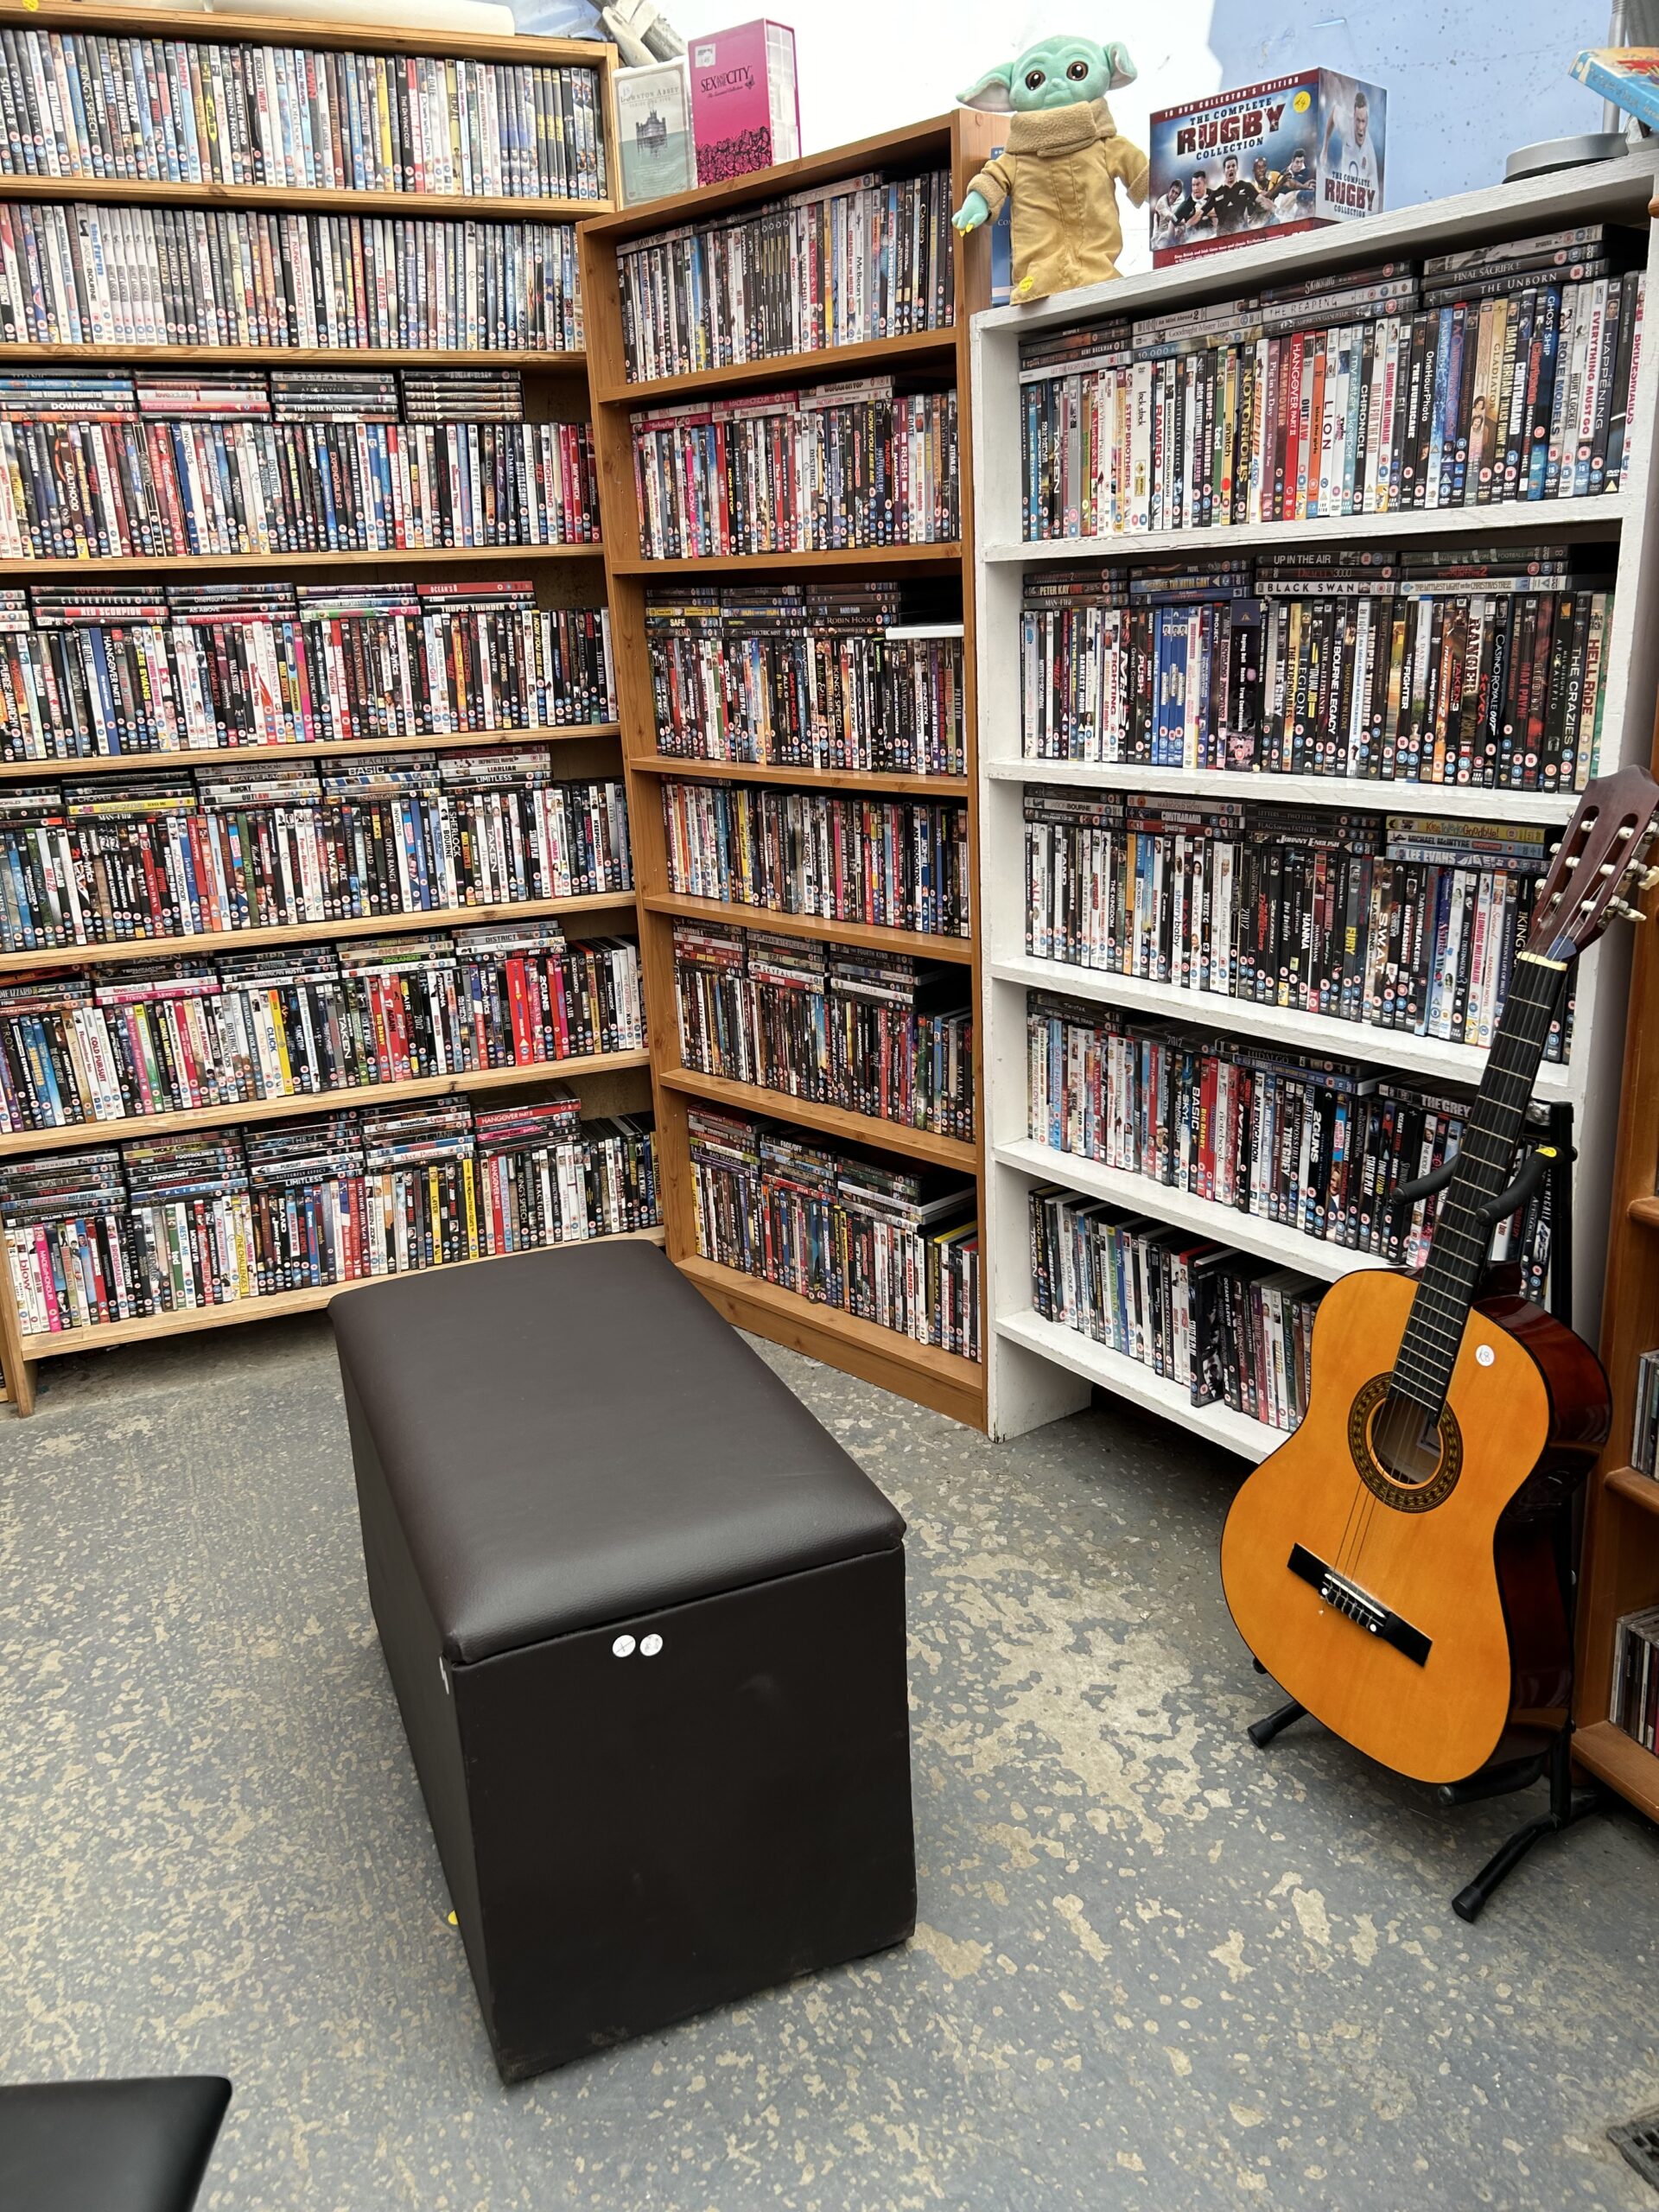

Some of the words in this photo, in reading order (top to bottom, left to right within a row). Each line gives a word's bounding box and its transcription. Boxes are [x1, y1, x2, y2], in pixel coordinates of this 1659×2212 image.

[701, 77, 716, 92] SEX
[726, 66, 753, 84] CITY
[1262, 76, 1300, 92] EDITION
[1190, 113, 1210, 125] THE
[1213, 98, 1272, 119] COMPLETE
[1177, 103, 1286, 156] RUGBY
[1196, 137, 1263, 160] COLLECTION
[1325, 178, 1376, 212] RUGBY
[1344, 174, 1370, 187] COMPLETE
[1334, 204, 1365, 218] COLLECTION
[1453, 270, 1478, 283] FINAL
[1480, 283, 1501, 295] THE
[1507, 273, 1556, 289] UNBORN
[1292, 296, 1337, 314] REAPING
[1546, 296, 1554, 331] GHOST
[1169, 327, 1197, 338] Goodnight
[1198, 323, 1215, 333] Mister
[1543, 333, 1552, 355] SHIP
[1587, 310, 1601, 381] EVERYTHING
[1556, 341, 1567, 376] ROLE
[1290, 344, 1301, 408] HANGOVER
[1385, 363, 1395, 400] SLUMDOG
[1421, 352, 1434, 422] OneHourPhoto
[1489, 342, 1500, 409] GLADIATOR
[1571, 374, 1580, 397] HURT
[1595, 332, 1611, 429] HAPPENING
[51, 402, 105, 410] DOWNFALL
[1408, 385, 1417, 438] HURRICANE
[1510, 362, 1526, 435] CONTRABAND
[1552, 379, 1565, 435] MODELS
[1567, 399, 1578, 429] LOCKER
[1584, 386, 1593, 416] MUST
[1239, 368, 1252, 483] NOTORIOUS
[1300, 398, 1310, 441] OUTLAW
[1322, 401, 1334, 449] LION
[1357, 385, 1368, 459] CHRONICLE
[1382, 400, 1392, 444] MILLIONAIRE
[1582, 419, 1590, 434] GO
[183, 430, 194, 465] INVICTUS
[269, 459, 281, 498] DISTRICT
[544, 459, 553, 508] FIGHTING
[1274, 556, 1285, 564] UP
[1287, 556, 1295, 564] IN
[1316, 555, 1331, 563] AIR
[1268, 582, 1309, 592] BLACK
[1318, 584, 1354, 593] SWAN
[81, 607, 97, 616] RED
[99, 607, 141, 616] SCORPION
[1365, 625, 1376, 669] TROPIC
[1569, 648, 1581, 677] THE
[1276, 659, 1285, 683] THE
[1332, 647, 1341, 690] BOURNE
[1275, 685, 1284, 717] GREY
[1296, 658, 1308, 716] LEGION
[1362, 671, 1372, 727] THUNDER
[1402, 666, 1411, 710] FIGHTER
[1328, 693, 1338, 735] LEGACY
[1564, 681, 1578, 745] CRAZIES
[347, 766, 385, 776] BASIC
[476, 773, 512, 783] LIMITLESS
[1161, 811, 1201, 824] CONTRABAND
[1276, 835, 1307, 845] JOHNNY
[1308, 838, 1339, 848] ENGLISH
[1405, 849, 1421, 860] LEE
[1423, 850, 1456, 862] EVANS
[1172, 890, 1183, 947] sherrybaby
[1301, 912, 1312, 950] HANNA
[1413, 893, 1425, 973] DAYBREAKERS
[1476, 912, 1486, 943] SLUMDOG
[486, 933, 516, 943] DISTRICT
[1345, 926, 1357, 956] FURY
[762, 967, 793, 978] SKYFALL
[266, 1027, 276, 1052] CLICK
[338, 1013, 351, 1059] TAKEN
[1192, 1087, 1200, 1131] BASIC
[1421, 1095, 1443, 1109] THE
[482, 1113, 518, 1124] HANGOVER
[1251, 1109, 1260, 1163] EDUCATION
[286, 1175, 324, 1186] LIMITLESS
